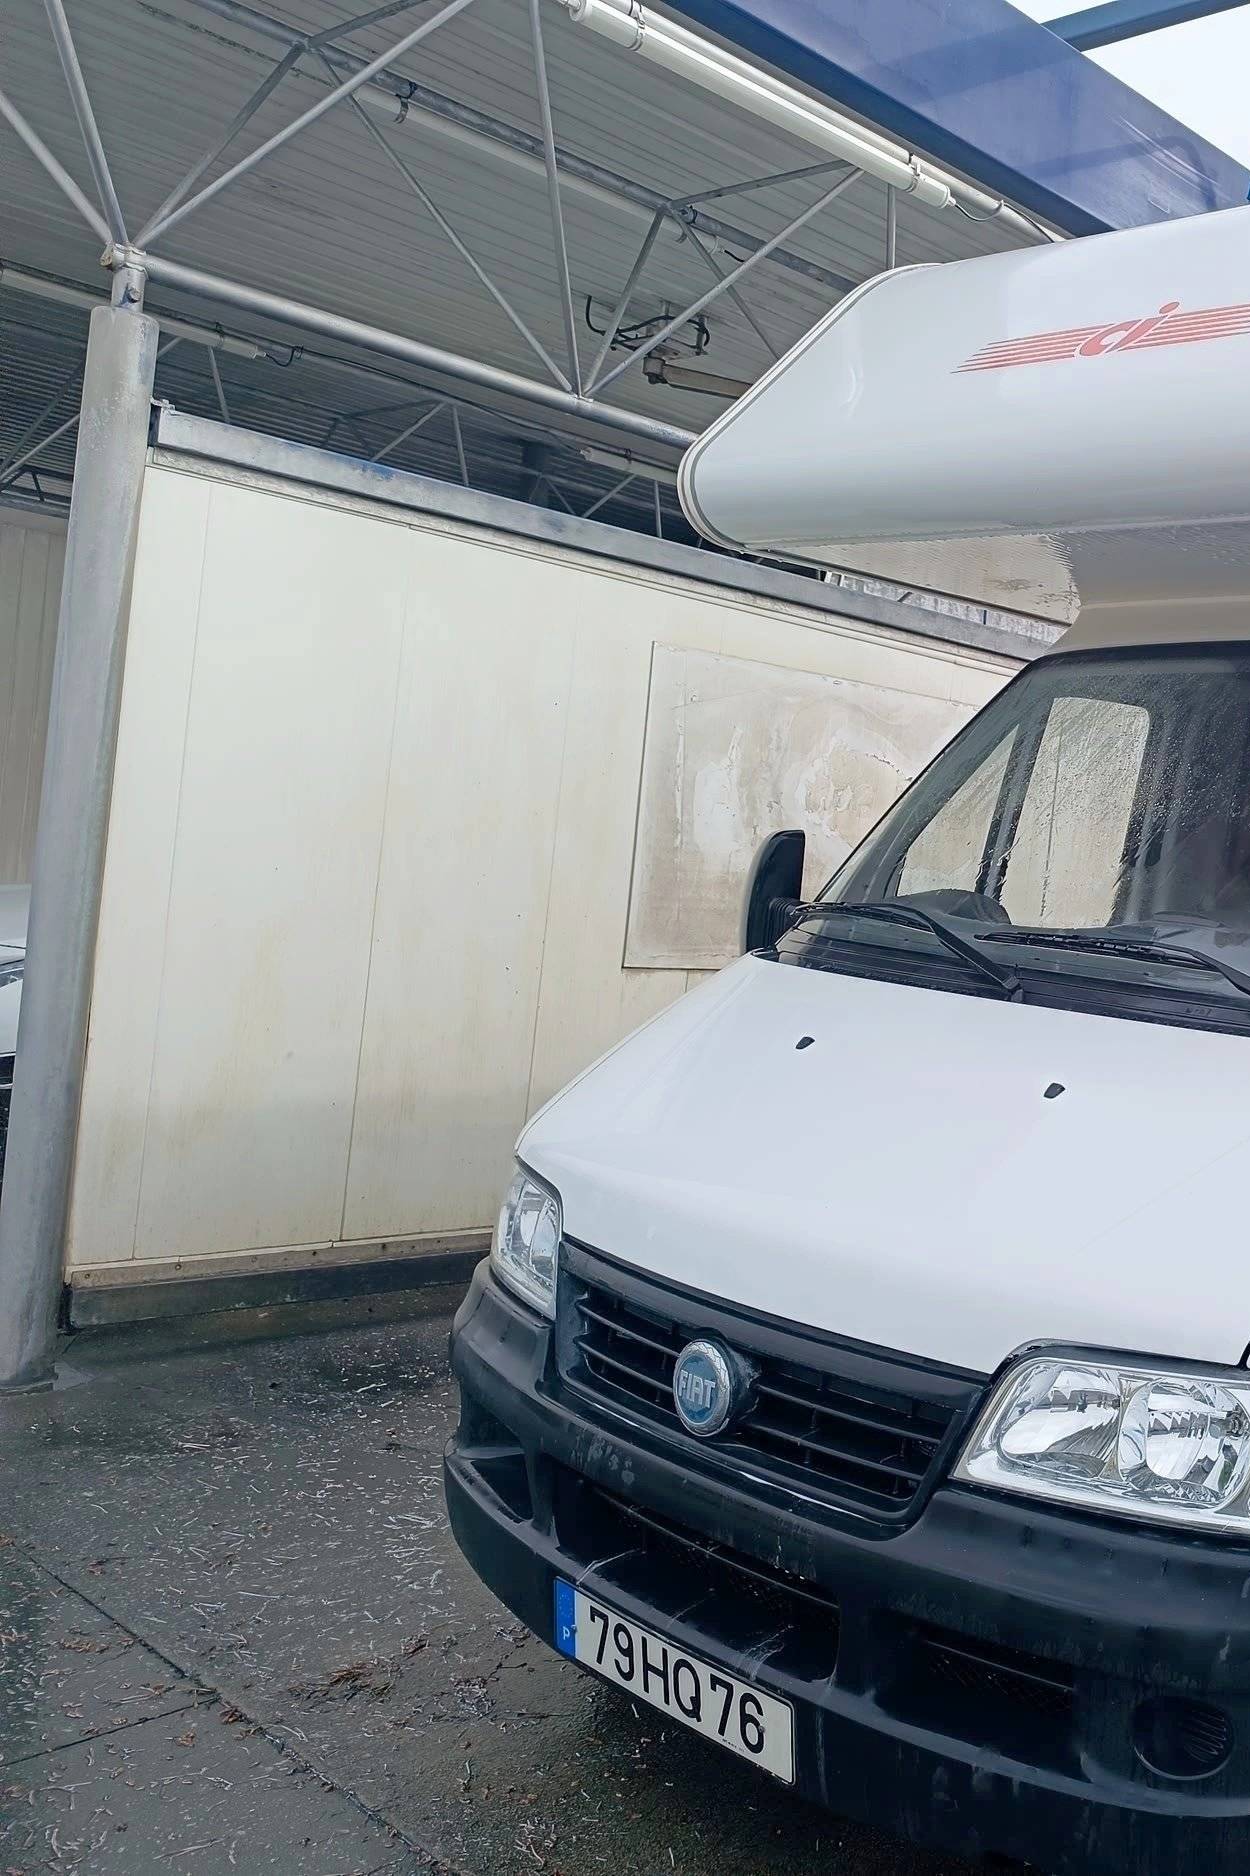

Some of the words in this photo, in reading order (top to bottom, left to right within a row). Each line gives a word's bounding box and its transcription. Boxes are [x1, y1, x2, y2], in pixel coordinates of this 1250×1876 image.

[678, 1369, 716, 1409] FIAT
[562, 1625, 571, 1641] P
[589, 1604, 765, 1755] 79HQ76
